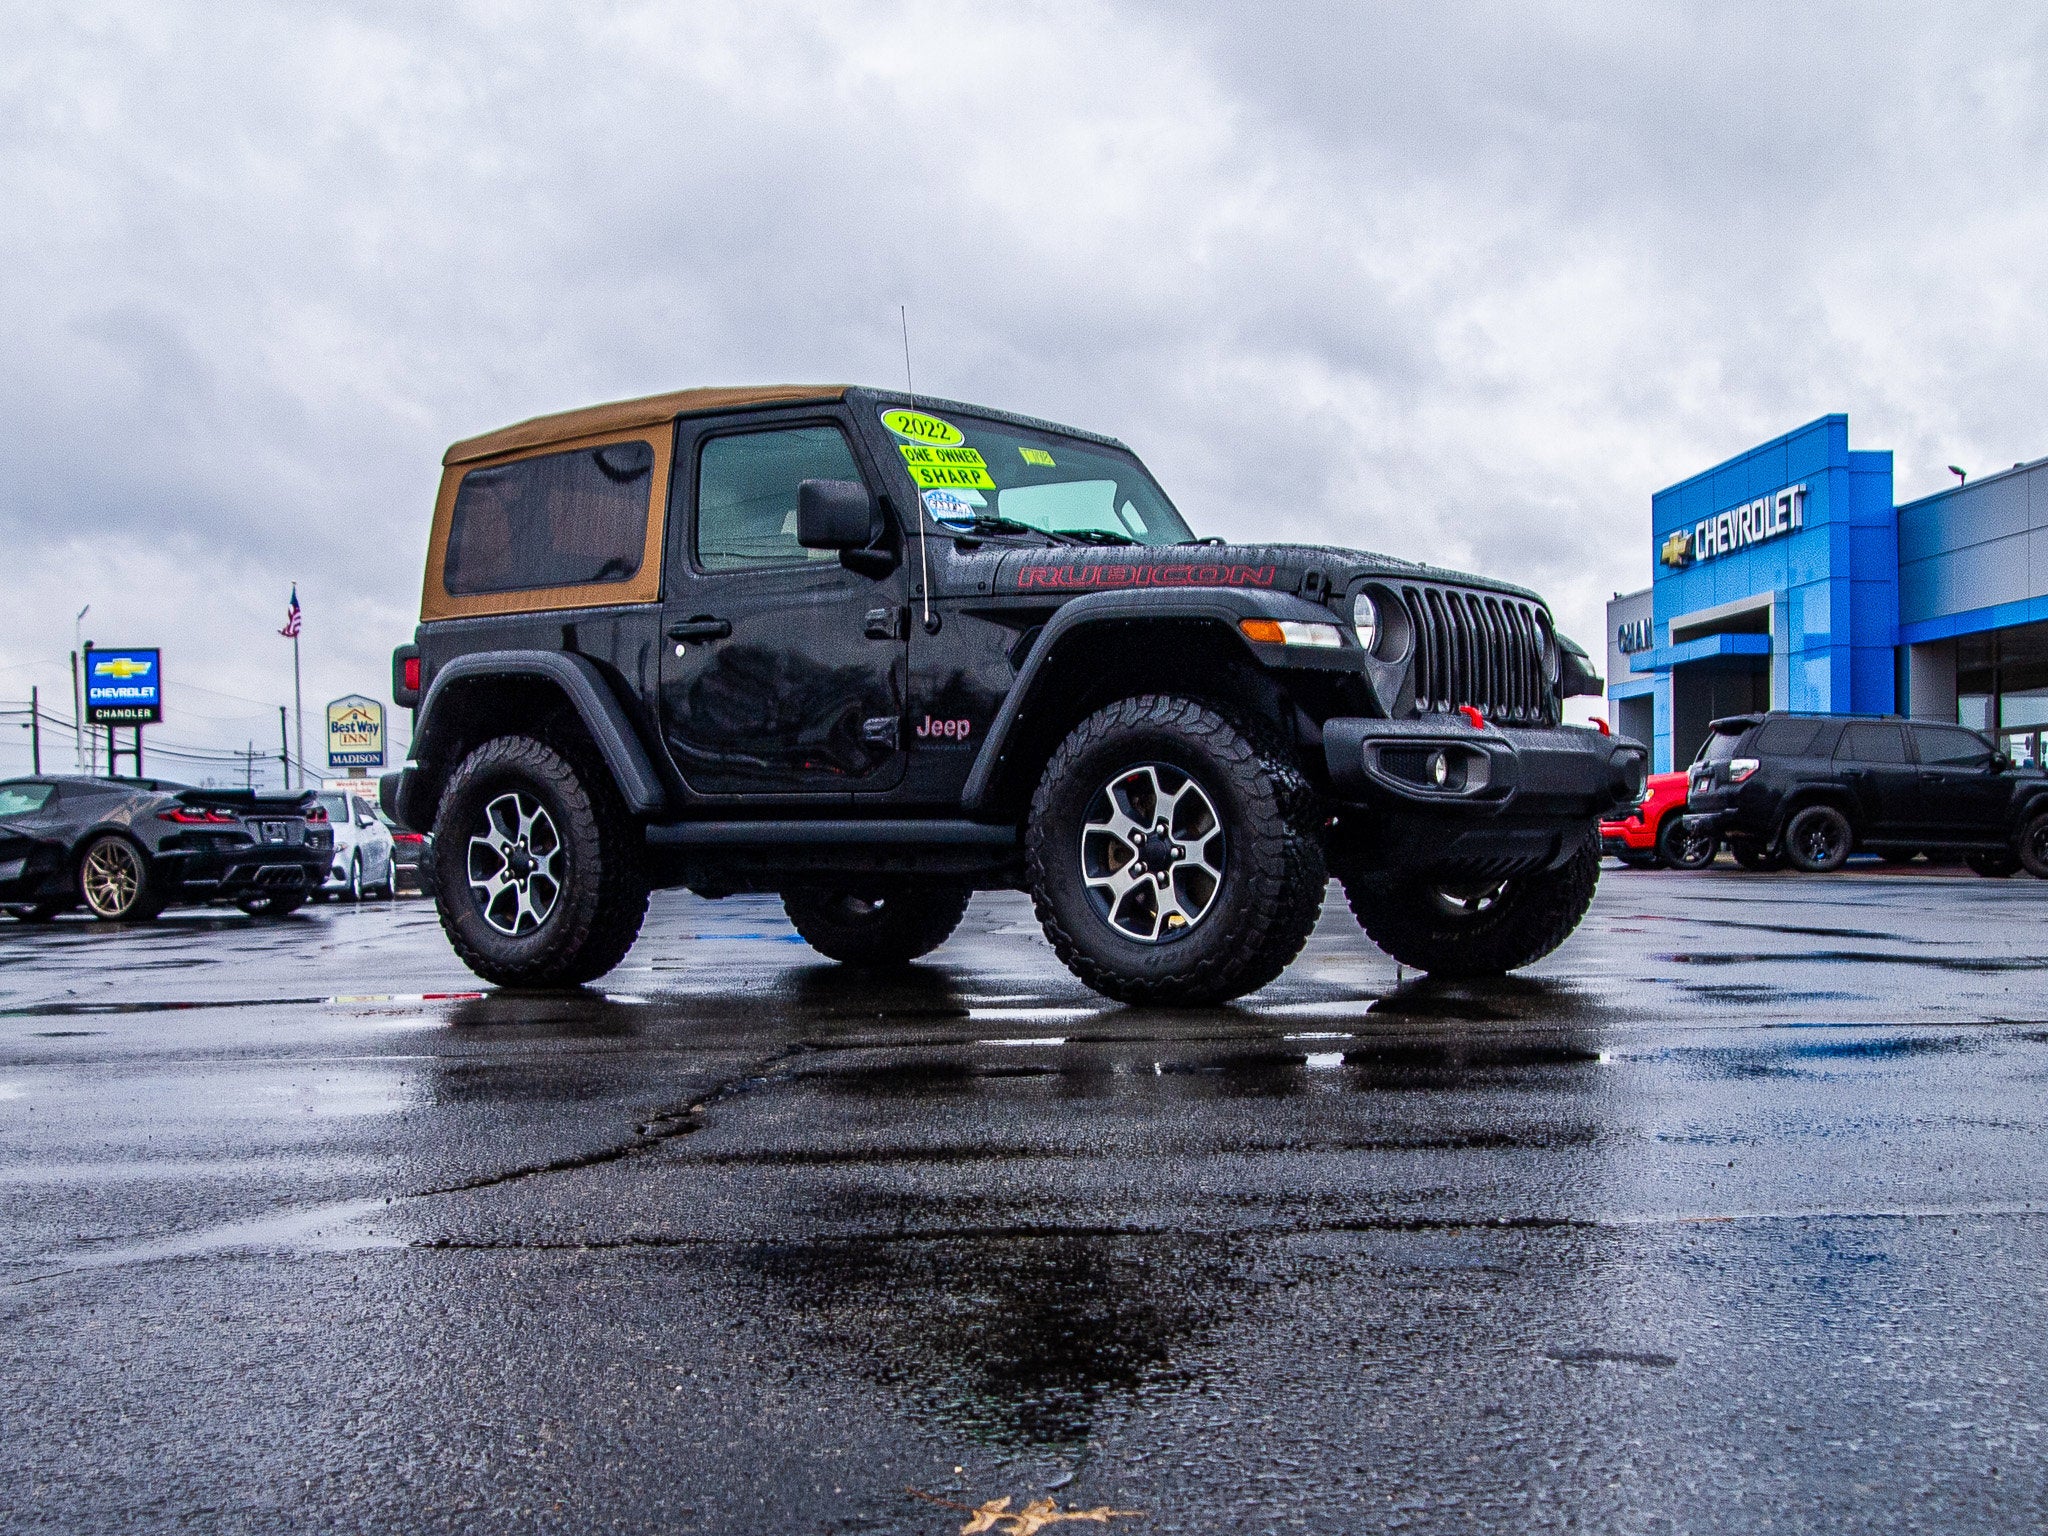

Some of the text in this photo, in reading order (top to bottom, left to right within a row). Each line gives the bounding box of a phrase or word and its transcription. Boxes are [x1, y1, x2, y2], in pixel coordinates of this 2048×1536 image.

[898, 416, 951, 441] 2022
[905, 447, 982, 463] ONE OWNER
[920, 468, 981, 484] SHARP
[1695, 483, 1807, 562] CHEVROLET
[1017, 564, 1276, 588] RUBICON
[90, 686, 155, 698] CHEVROLET
[96, 709, 152, 718] CHANDLER
[331, 721, 379, 736] Best Way
[916, 714, 971, 741] Jeep
[343, 733, 368, 743] INN
[332, 755, 380, 763] MADISON
